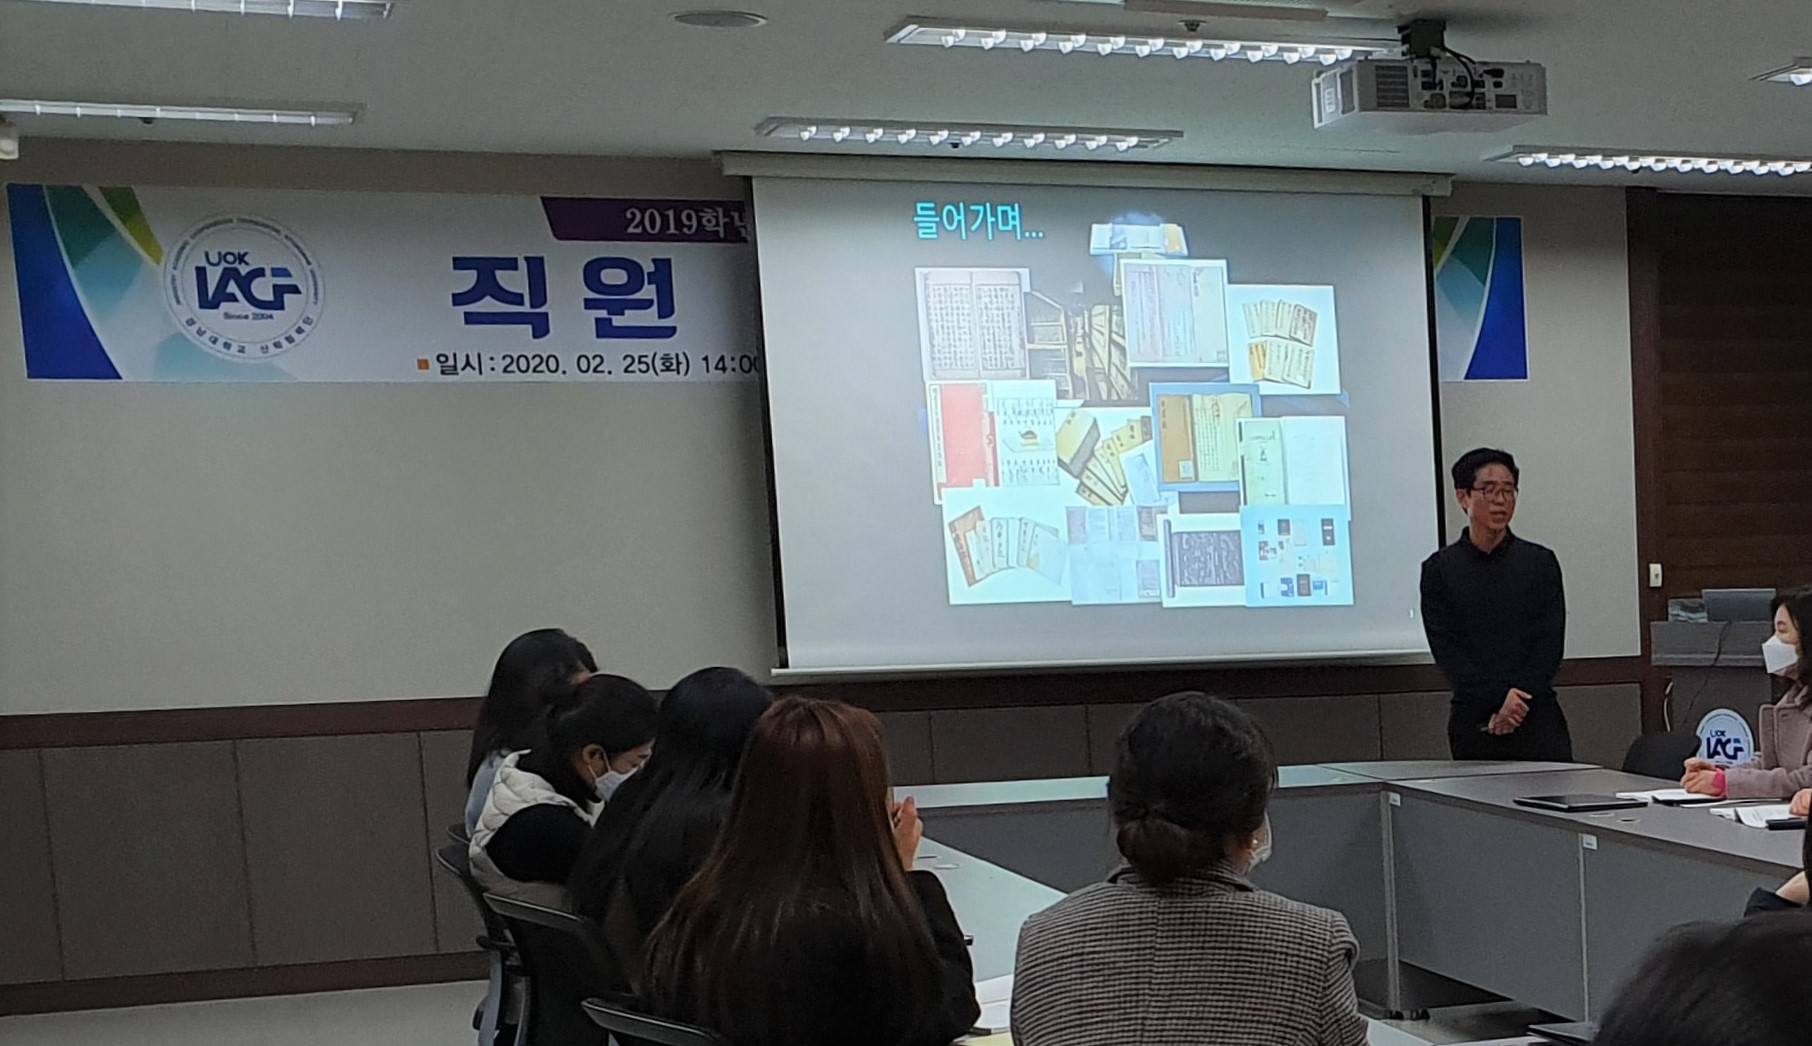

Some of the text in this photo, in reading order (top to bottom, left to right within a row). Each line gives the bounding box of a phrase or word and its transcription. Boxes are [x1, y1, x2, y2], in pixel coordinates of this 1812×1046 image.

[913, 202, 1043, 240] 들어가며...
[205, 251, 250, 267] UOK
[577, 354, 613, 375] 02.
[622, 353, 690, 376] 25(화)
